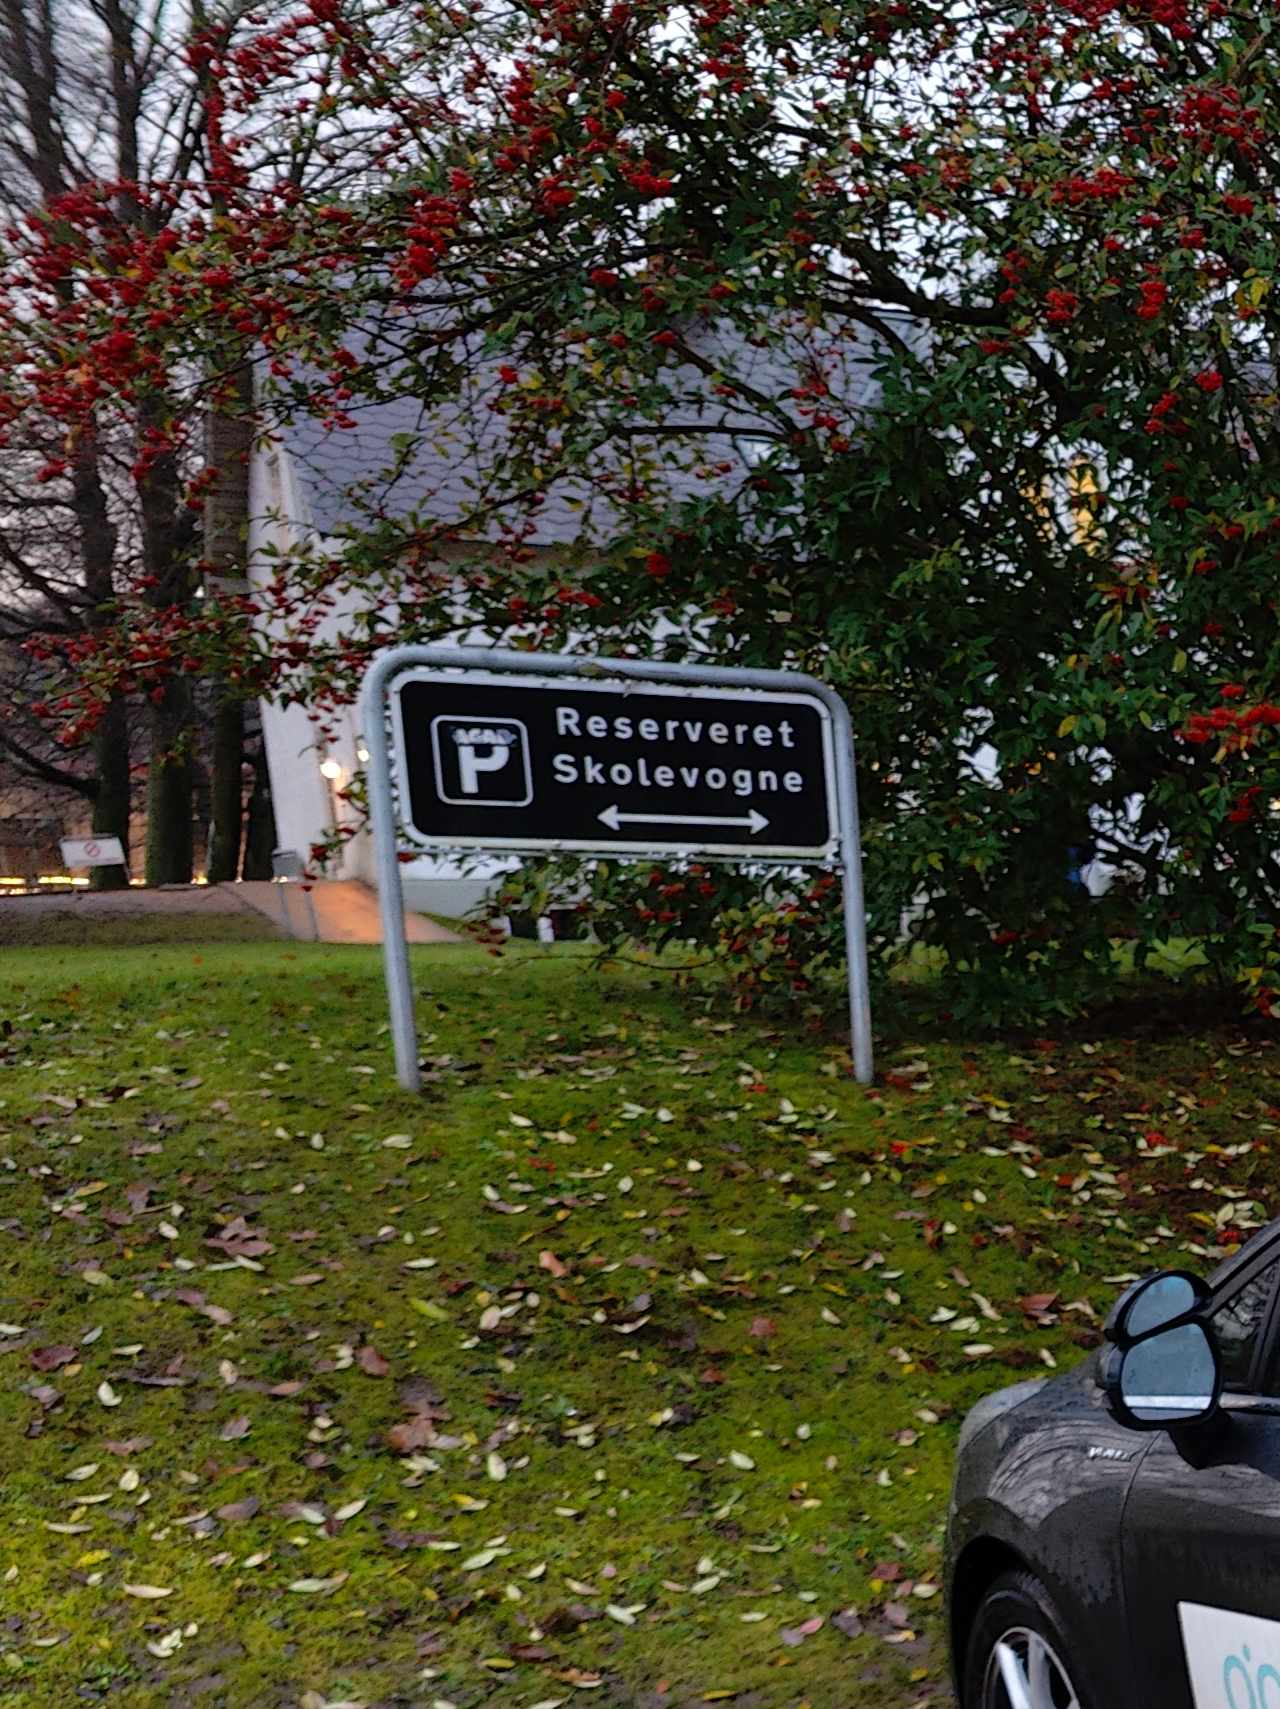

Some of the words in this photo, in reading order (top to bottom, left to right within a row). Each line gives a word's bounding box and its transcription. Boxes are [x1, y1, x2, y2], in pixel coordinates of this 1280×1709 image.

[555, 706, 795, 748] Reserveret
[457, 730, 510, 794] P
[552, 753, 803, 797] Skolevogne
